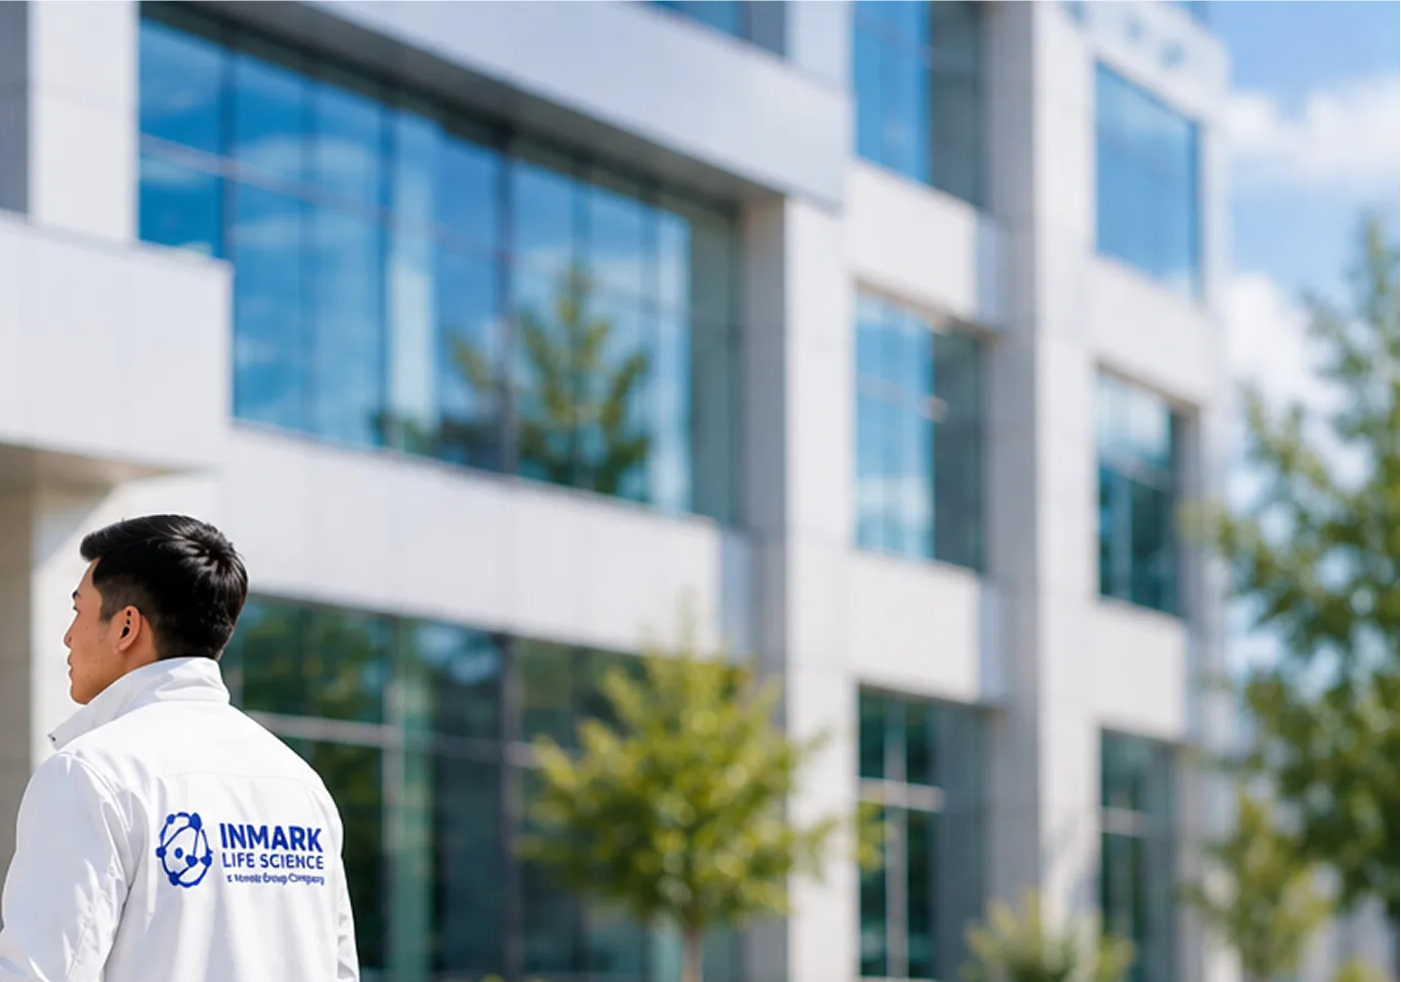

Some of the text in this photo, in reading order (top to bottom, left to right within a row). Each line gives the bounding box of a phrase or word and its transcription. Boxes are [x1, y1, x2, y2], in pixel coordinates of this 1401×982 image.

[219, 823, 323, 852] INMARK
[221, 852, 325, 869] LIFE SCIENCE
